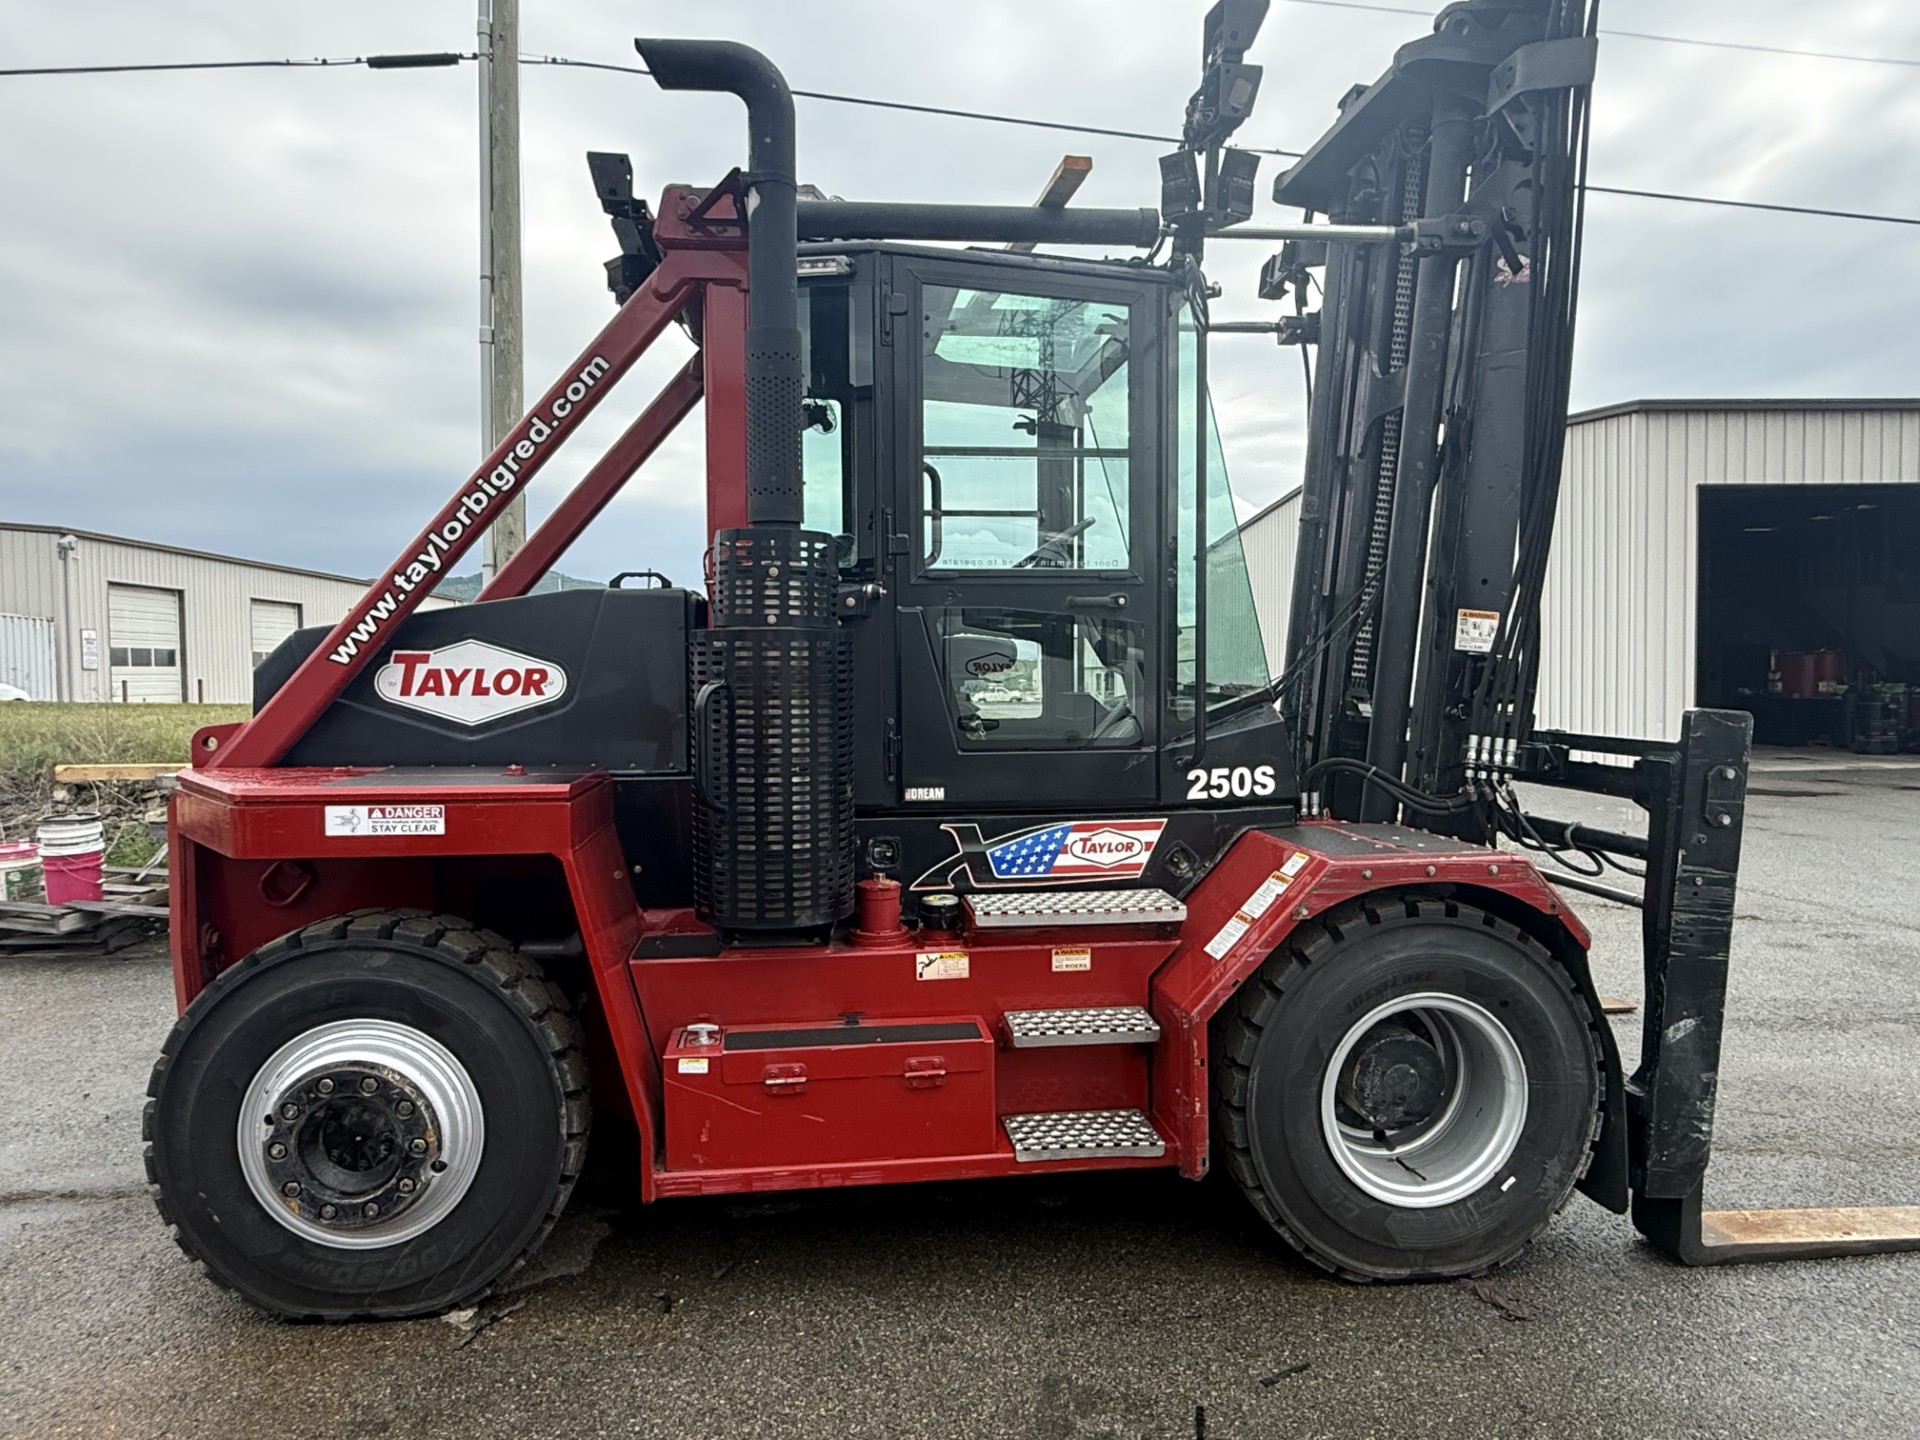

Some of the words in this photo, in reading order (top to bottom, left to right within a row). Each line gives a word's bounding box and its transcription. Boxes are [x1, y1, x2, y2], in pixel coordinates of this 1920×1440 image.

[328, 355, 611, 666] www.taylorbigred.com
[393, 653, 549, 697] TAYLOR
[1186, 765, 1276, 800] 250S
[385, 807, 441, 818] DANGER
[371, 824, 397, 833] STAY
[401, 824, 437, 833] CLEAR
[1079, 837, 1135, 855] TAYLOR
